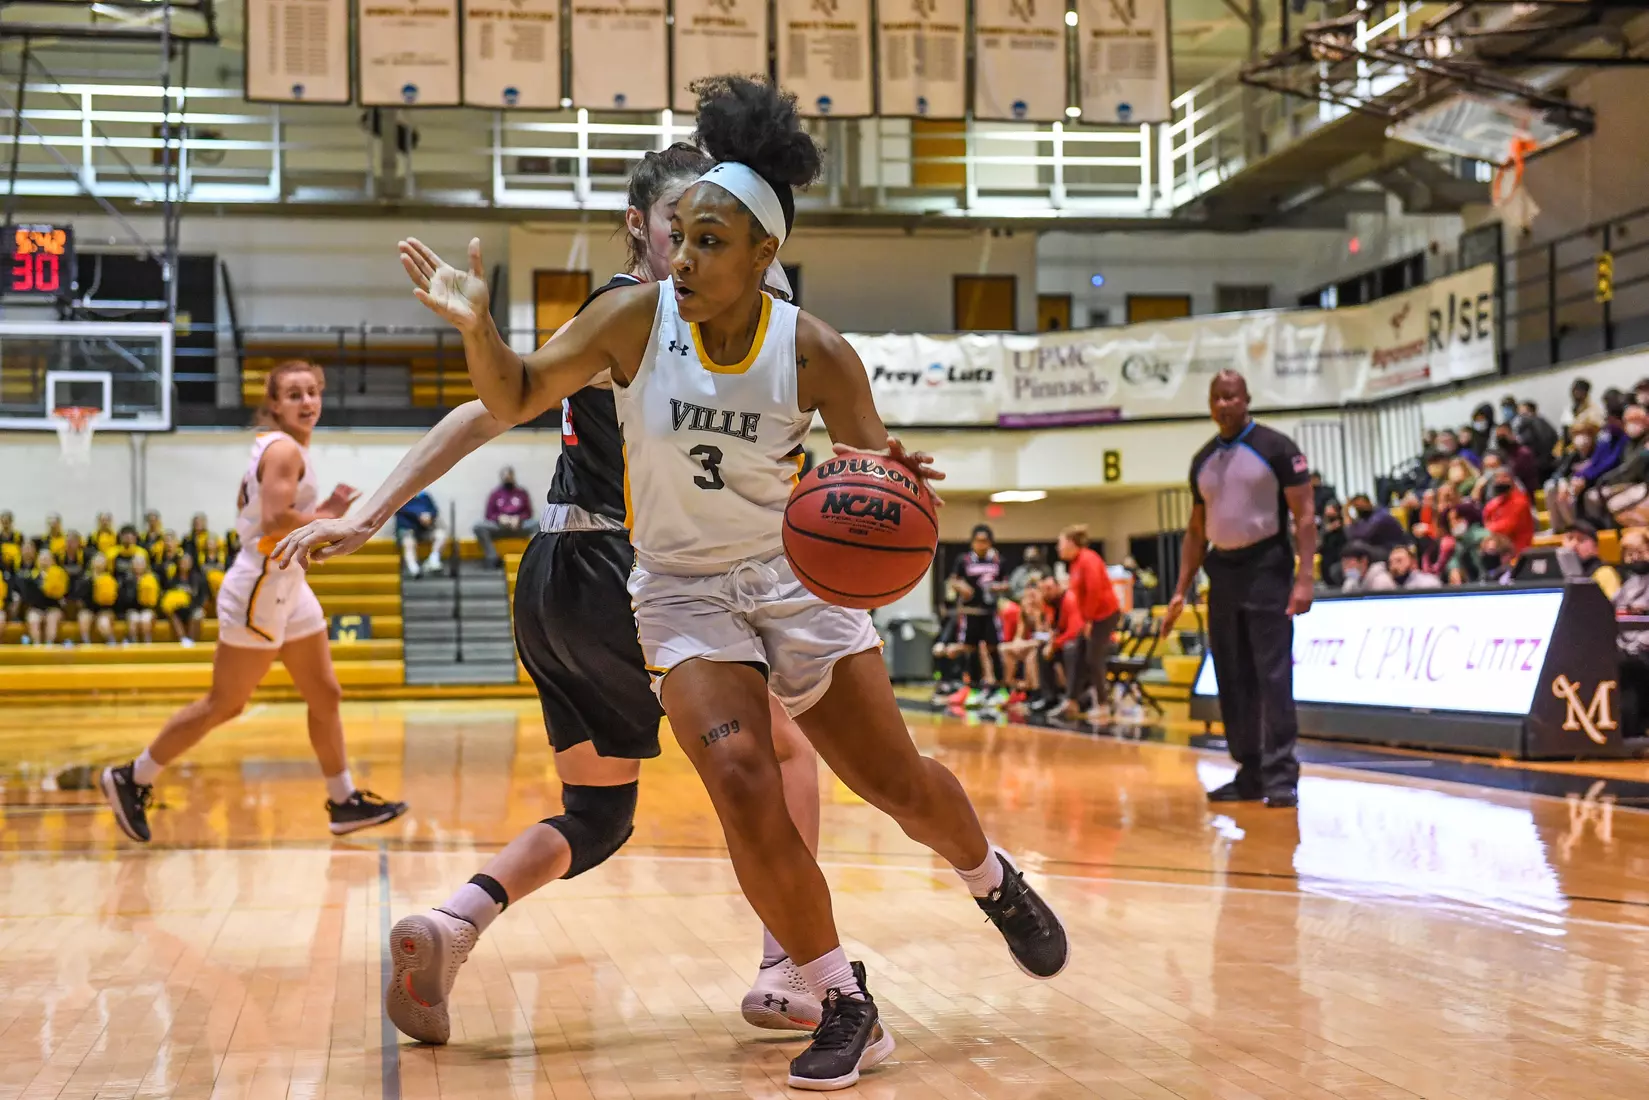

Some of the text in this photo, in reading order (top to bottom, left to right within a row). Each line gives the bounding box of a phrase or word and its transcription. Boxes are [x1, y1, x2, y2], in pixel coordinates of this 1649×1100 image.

[12, 253, 59, 291] 30
[669, 397, 761, 443] VILLE
[689, 444, 725, 490] 3
[820, 490, 901, 526] NCAA
[701, 719, 740, 748] 1999
